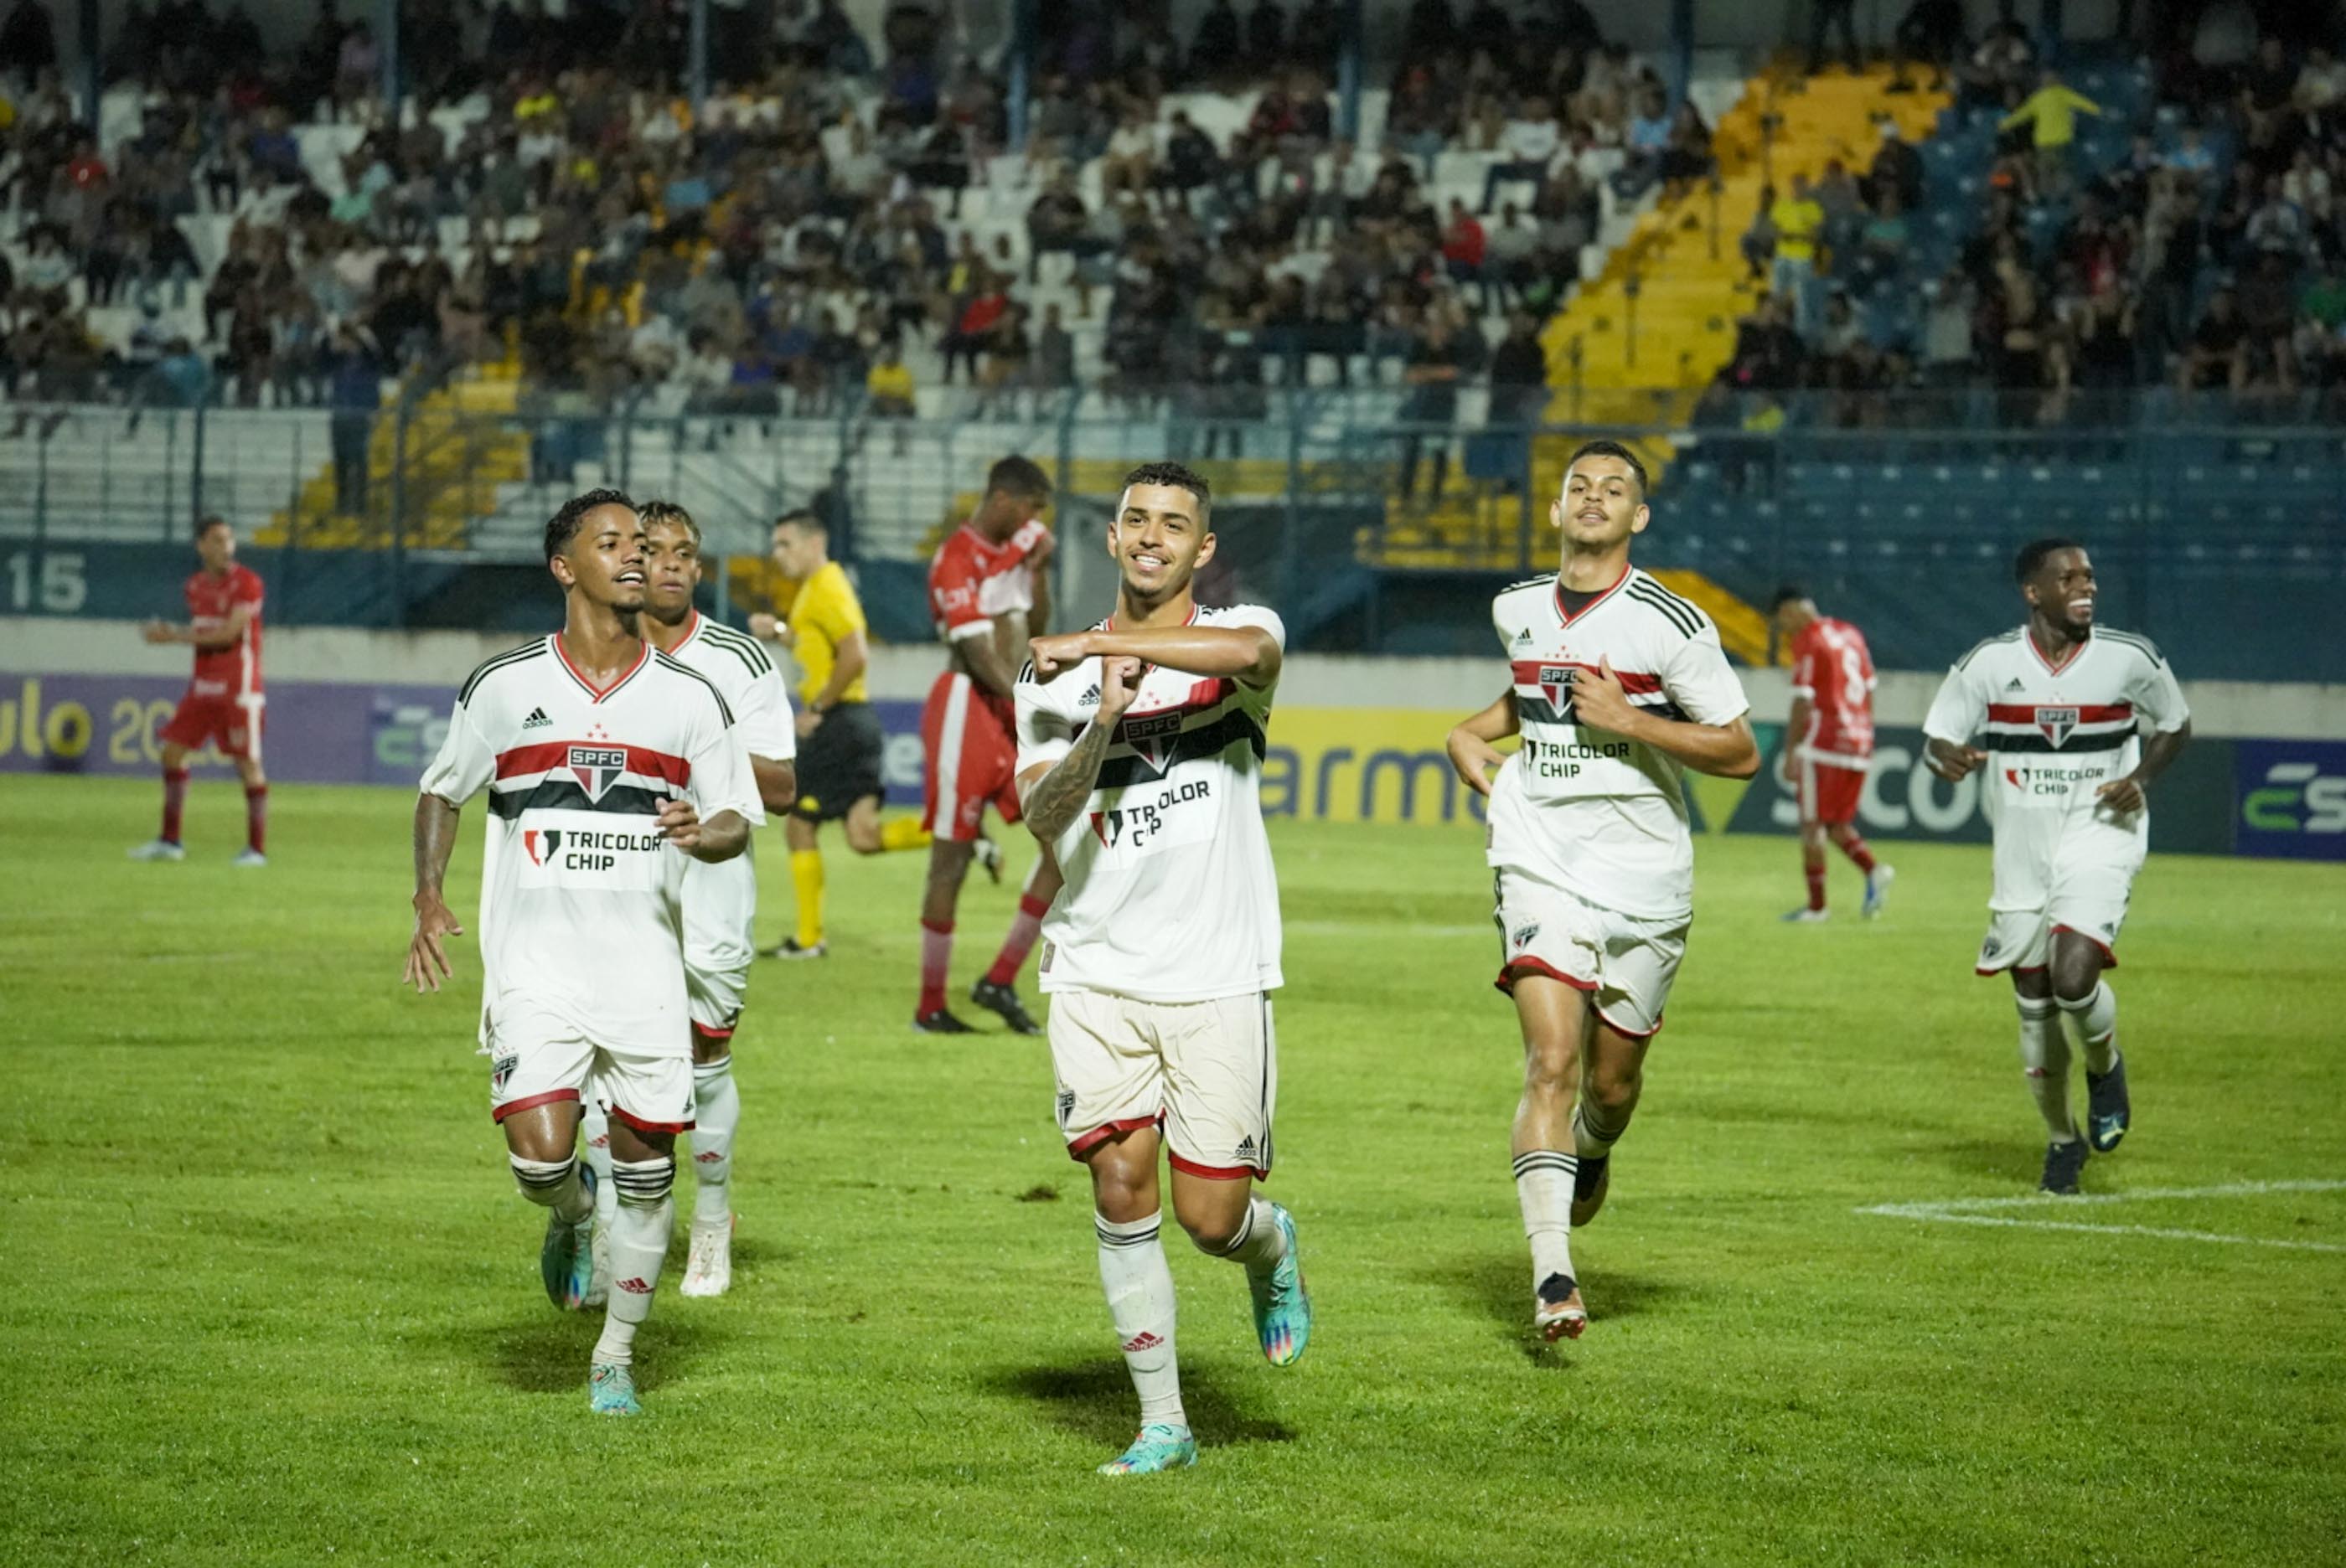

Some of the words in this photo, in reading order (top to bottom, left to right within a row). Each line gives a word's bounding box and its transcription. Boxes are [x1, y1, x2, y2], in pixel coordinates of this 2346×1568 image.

[8, 553, 87, 611] 15
[1130, 717, 1181, 736] SPFC
[571, 751, 623, 766] SPFC
[1540, 743, 1630, 759] TRICOLOR
[1540, 762, 1581, 777] CHIP
[2033, 767, 2106, 781] TRICOLOR
[2034, 783, 2069, 795] CHIP
[1127, 781, 1211, 825] TROLOR
[566, 831, 662, 851] TRICOLOR
[566, 854, 615, 871] CHIP
